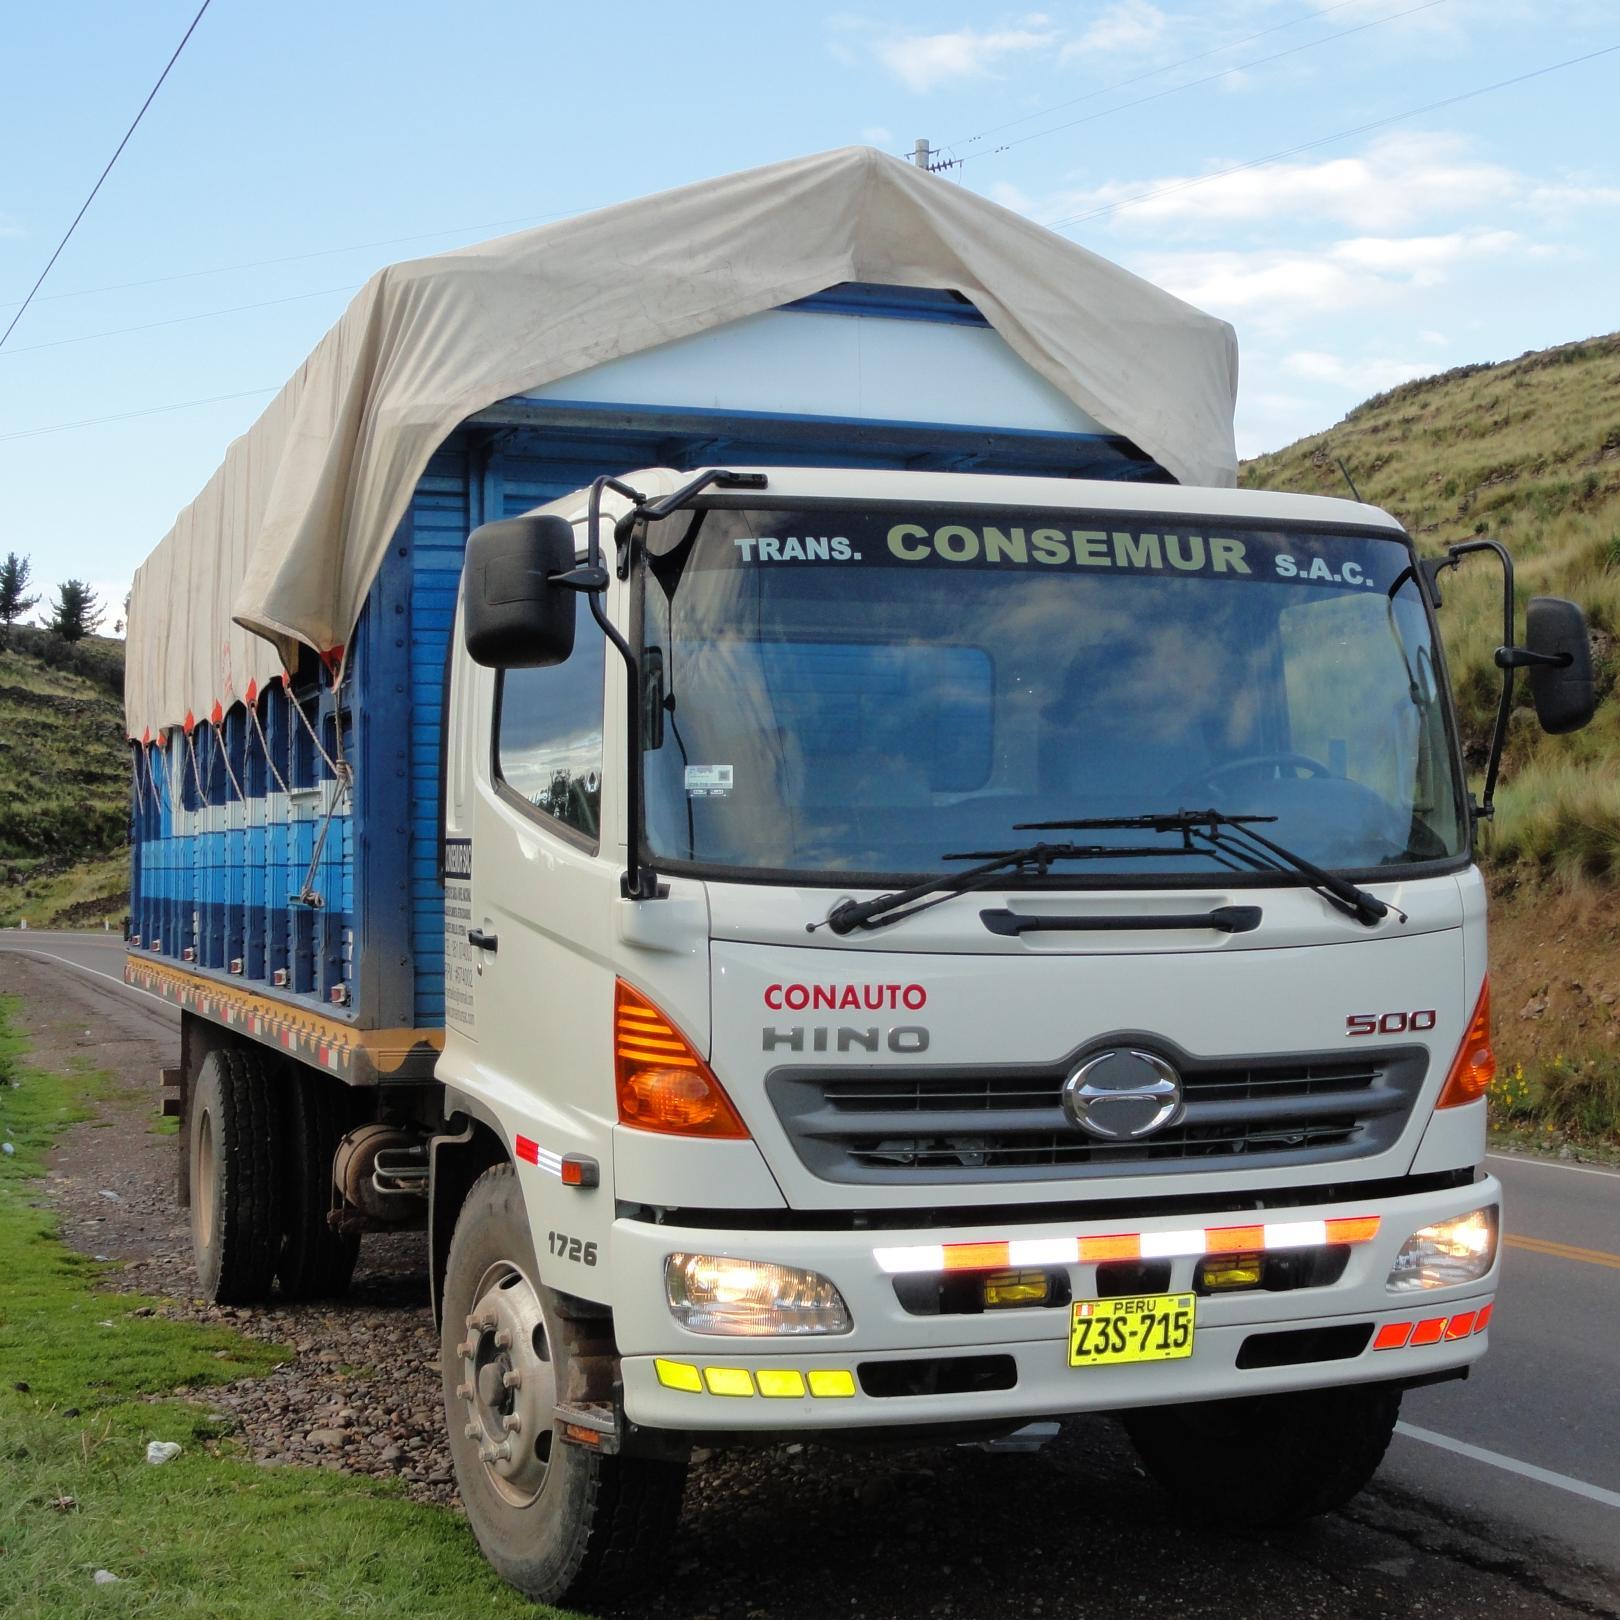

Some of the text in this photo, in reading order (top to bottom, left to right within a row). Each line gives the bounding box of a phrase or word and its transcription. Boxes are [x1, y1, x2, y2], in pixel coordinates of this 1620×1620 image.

[734, 524, 1375, 587] TRANS. CONSEMUR S.A.C.
[764, 984, 927, 1010] CONAUTO
[1345, 1009, 1436, 1036] 500
[762, 1026, 930, 1053] HINO
[548, 1230, 598, 1267] 1726
[1113, 1300, 1157, 1315] PERU
[1075, 1311, 1189, 1356] Z3S-715
